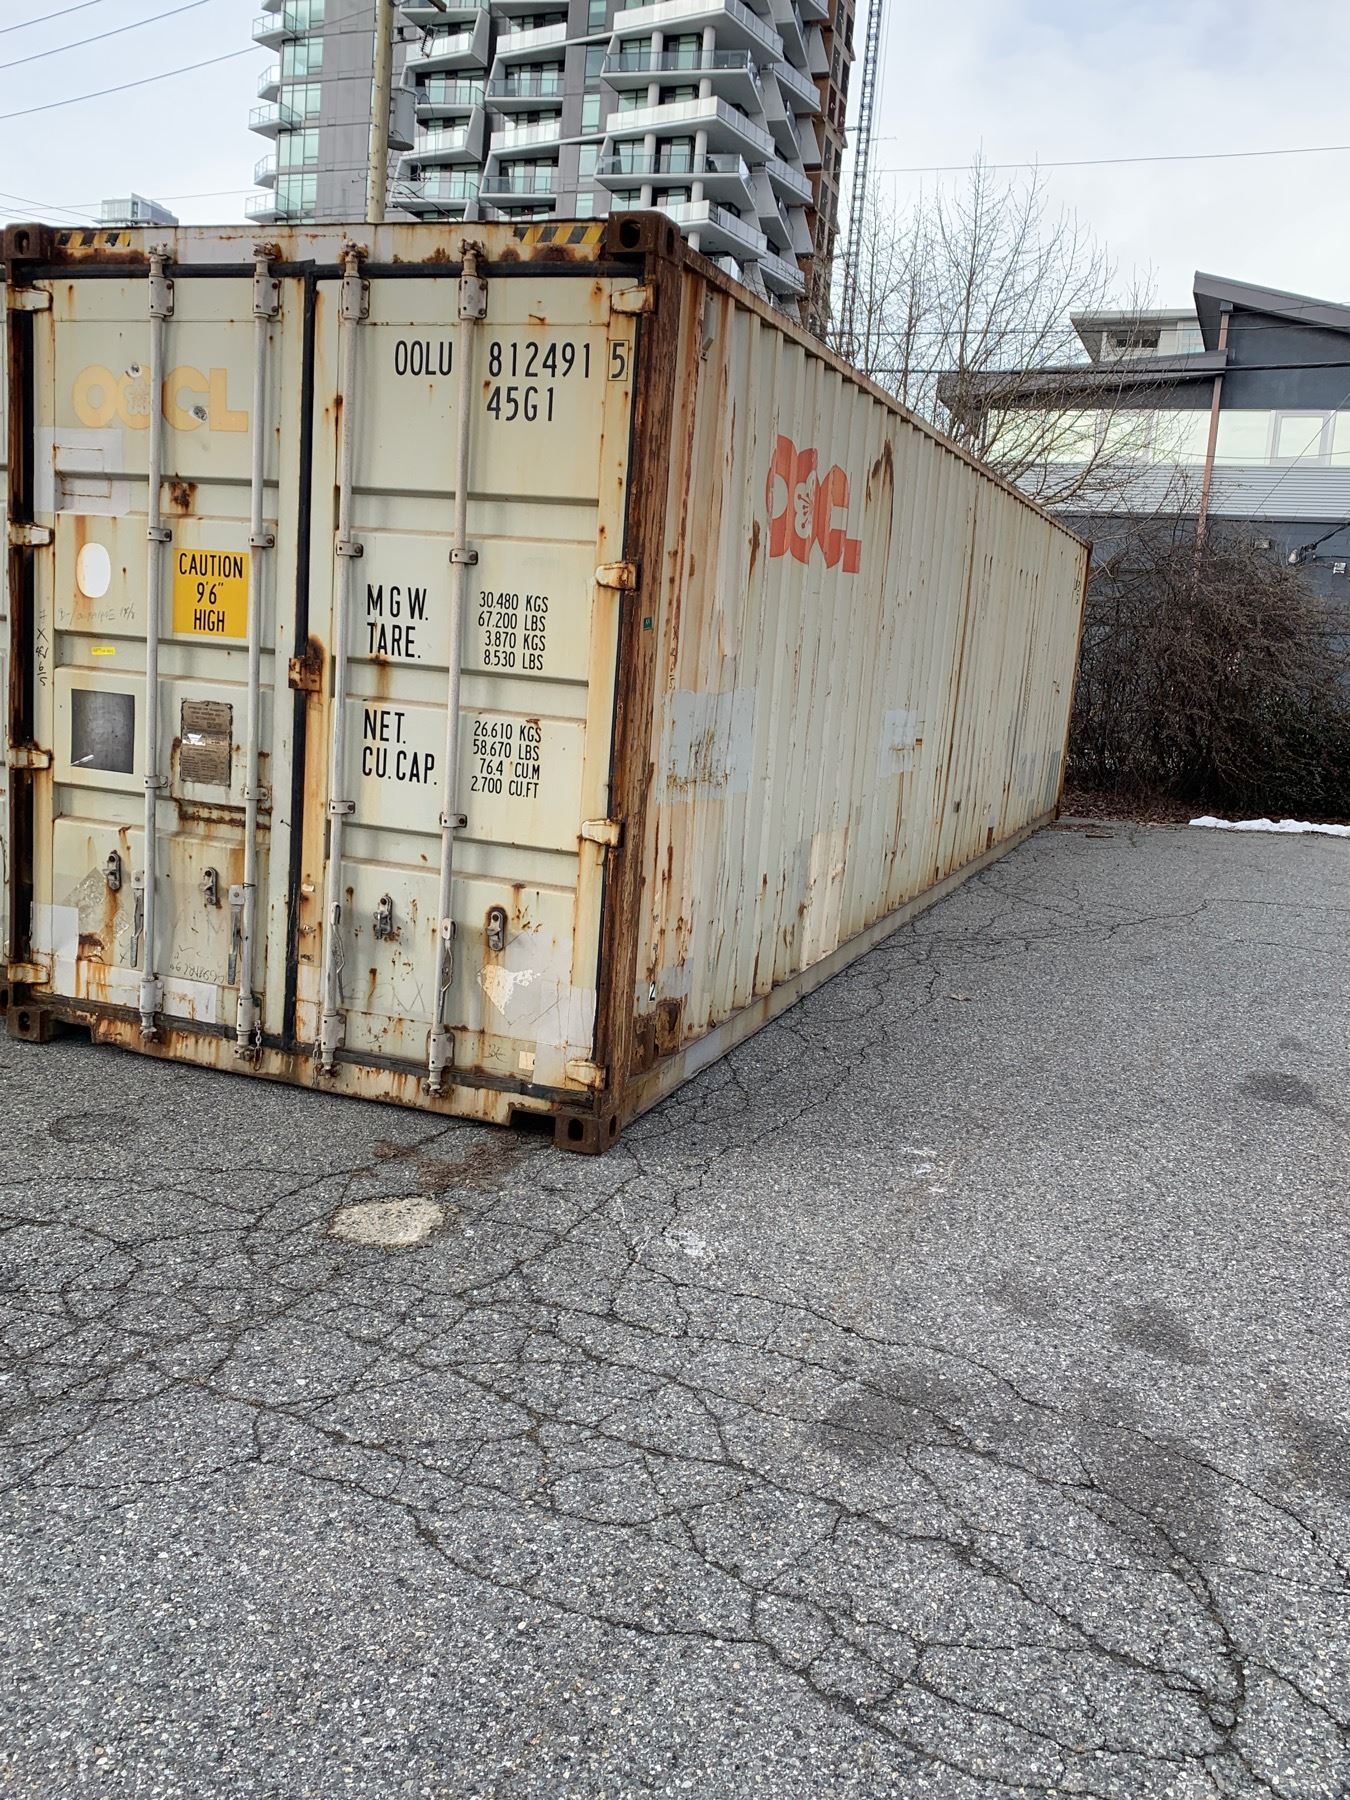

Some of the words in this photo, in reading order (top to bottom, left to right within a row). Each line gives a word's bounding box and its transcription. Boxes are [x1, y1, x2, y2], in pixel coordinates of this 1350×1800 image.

[489, 341, 590, 379] 812491
[611, 342, 626, 379] 5
[486, 386, 554, 421] 45G1
[179, 553, 243, 578] CAUTION
[525, 595, 549, 613] KGS
[193, 608, 225, 632] HIGH
[524, 615, 546, 632] LBS
[367, 622, 421, 659] TARE.
[523, 633, 546, 651] KGS
[522, 652, 543, 670] LBS
[363, 708, 406, 744] NET.
[519, 725, 542, 743] KGS
[518, 744, 540, 761] LBS
[479, 758, 503, 775] 76.4
[514, 763, 541, 780] CU.M
[508, 780, 539, 798] CU.FT
[649, 981, 656, 1002] 2
